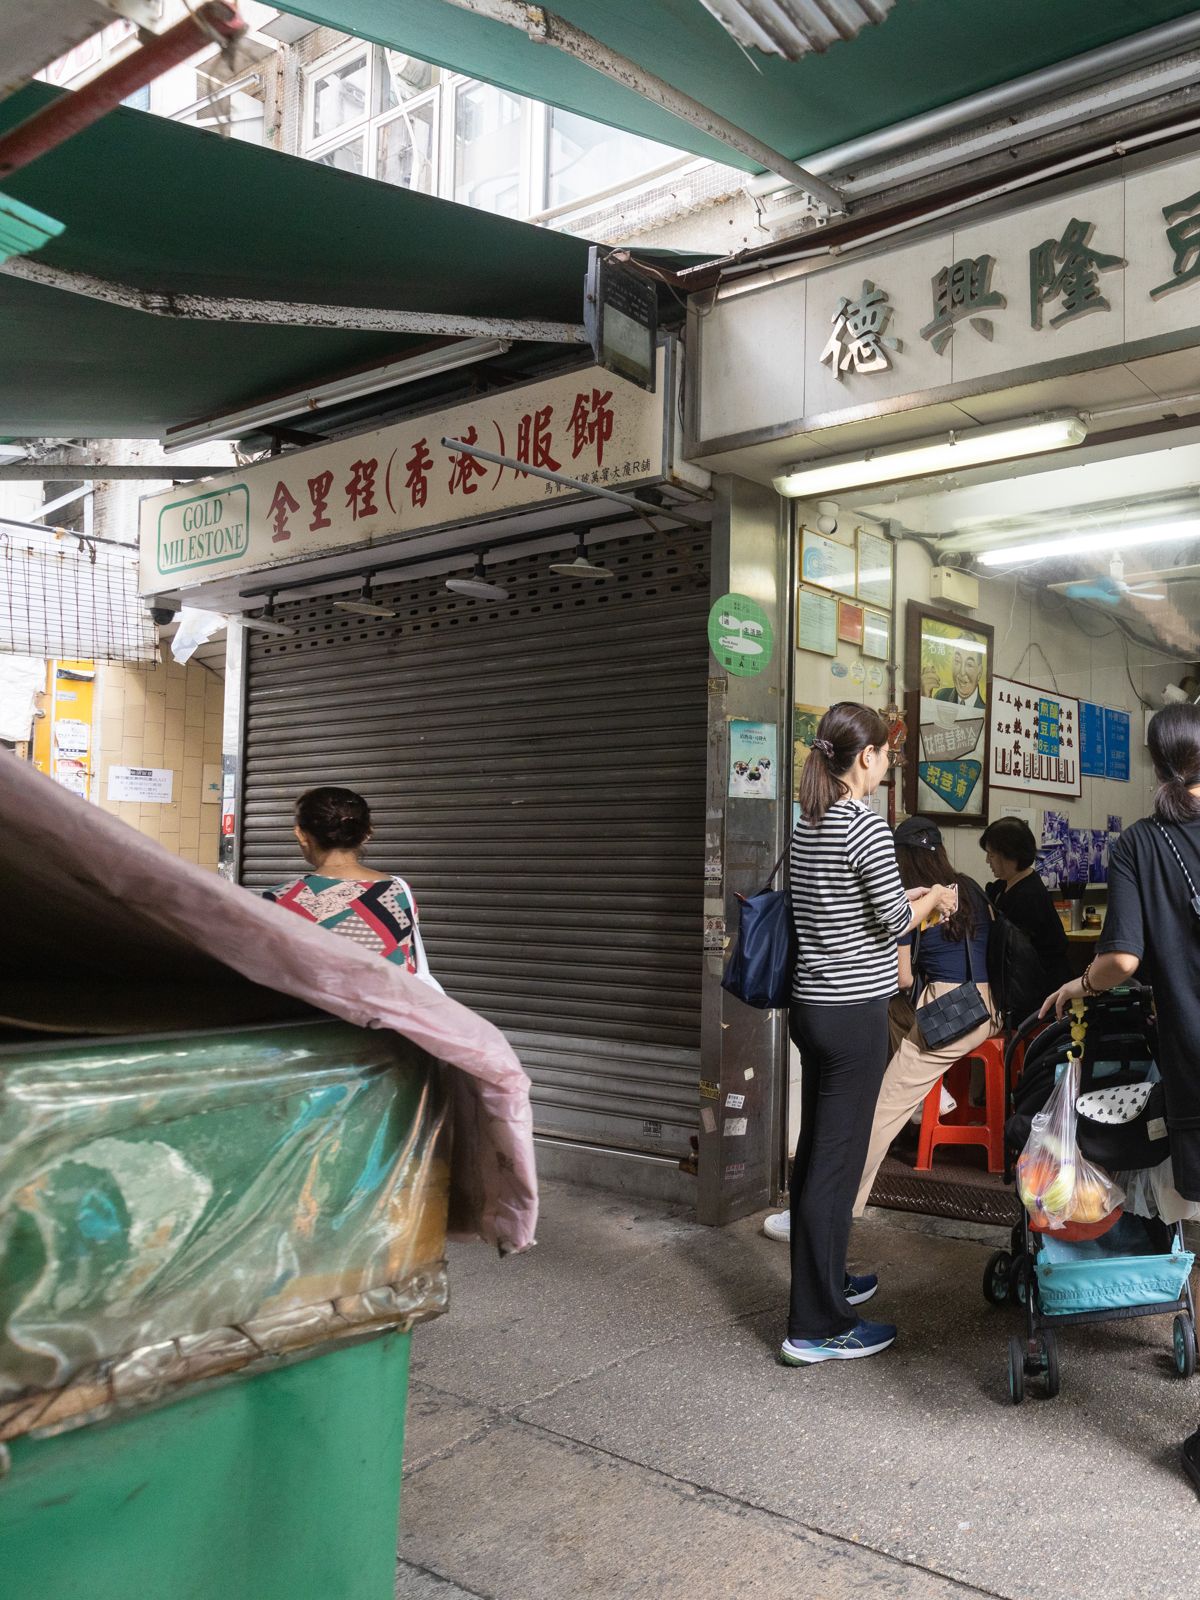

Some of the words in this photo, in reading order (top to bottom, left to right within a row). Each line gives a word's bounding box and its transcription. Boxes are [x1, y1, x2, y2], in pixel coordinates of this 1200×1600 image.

[266, 388, 614, 543] 金里程(香港)服飾
[182, 498, 223, 532] GOLD
[163, 523, 244, 567] MILESTONE
